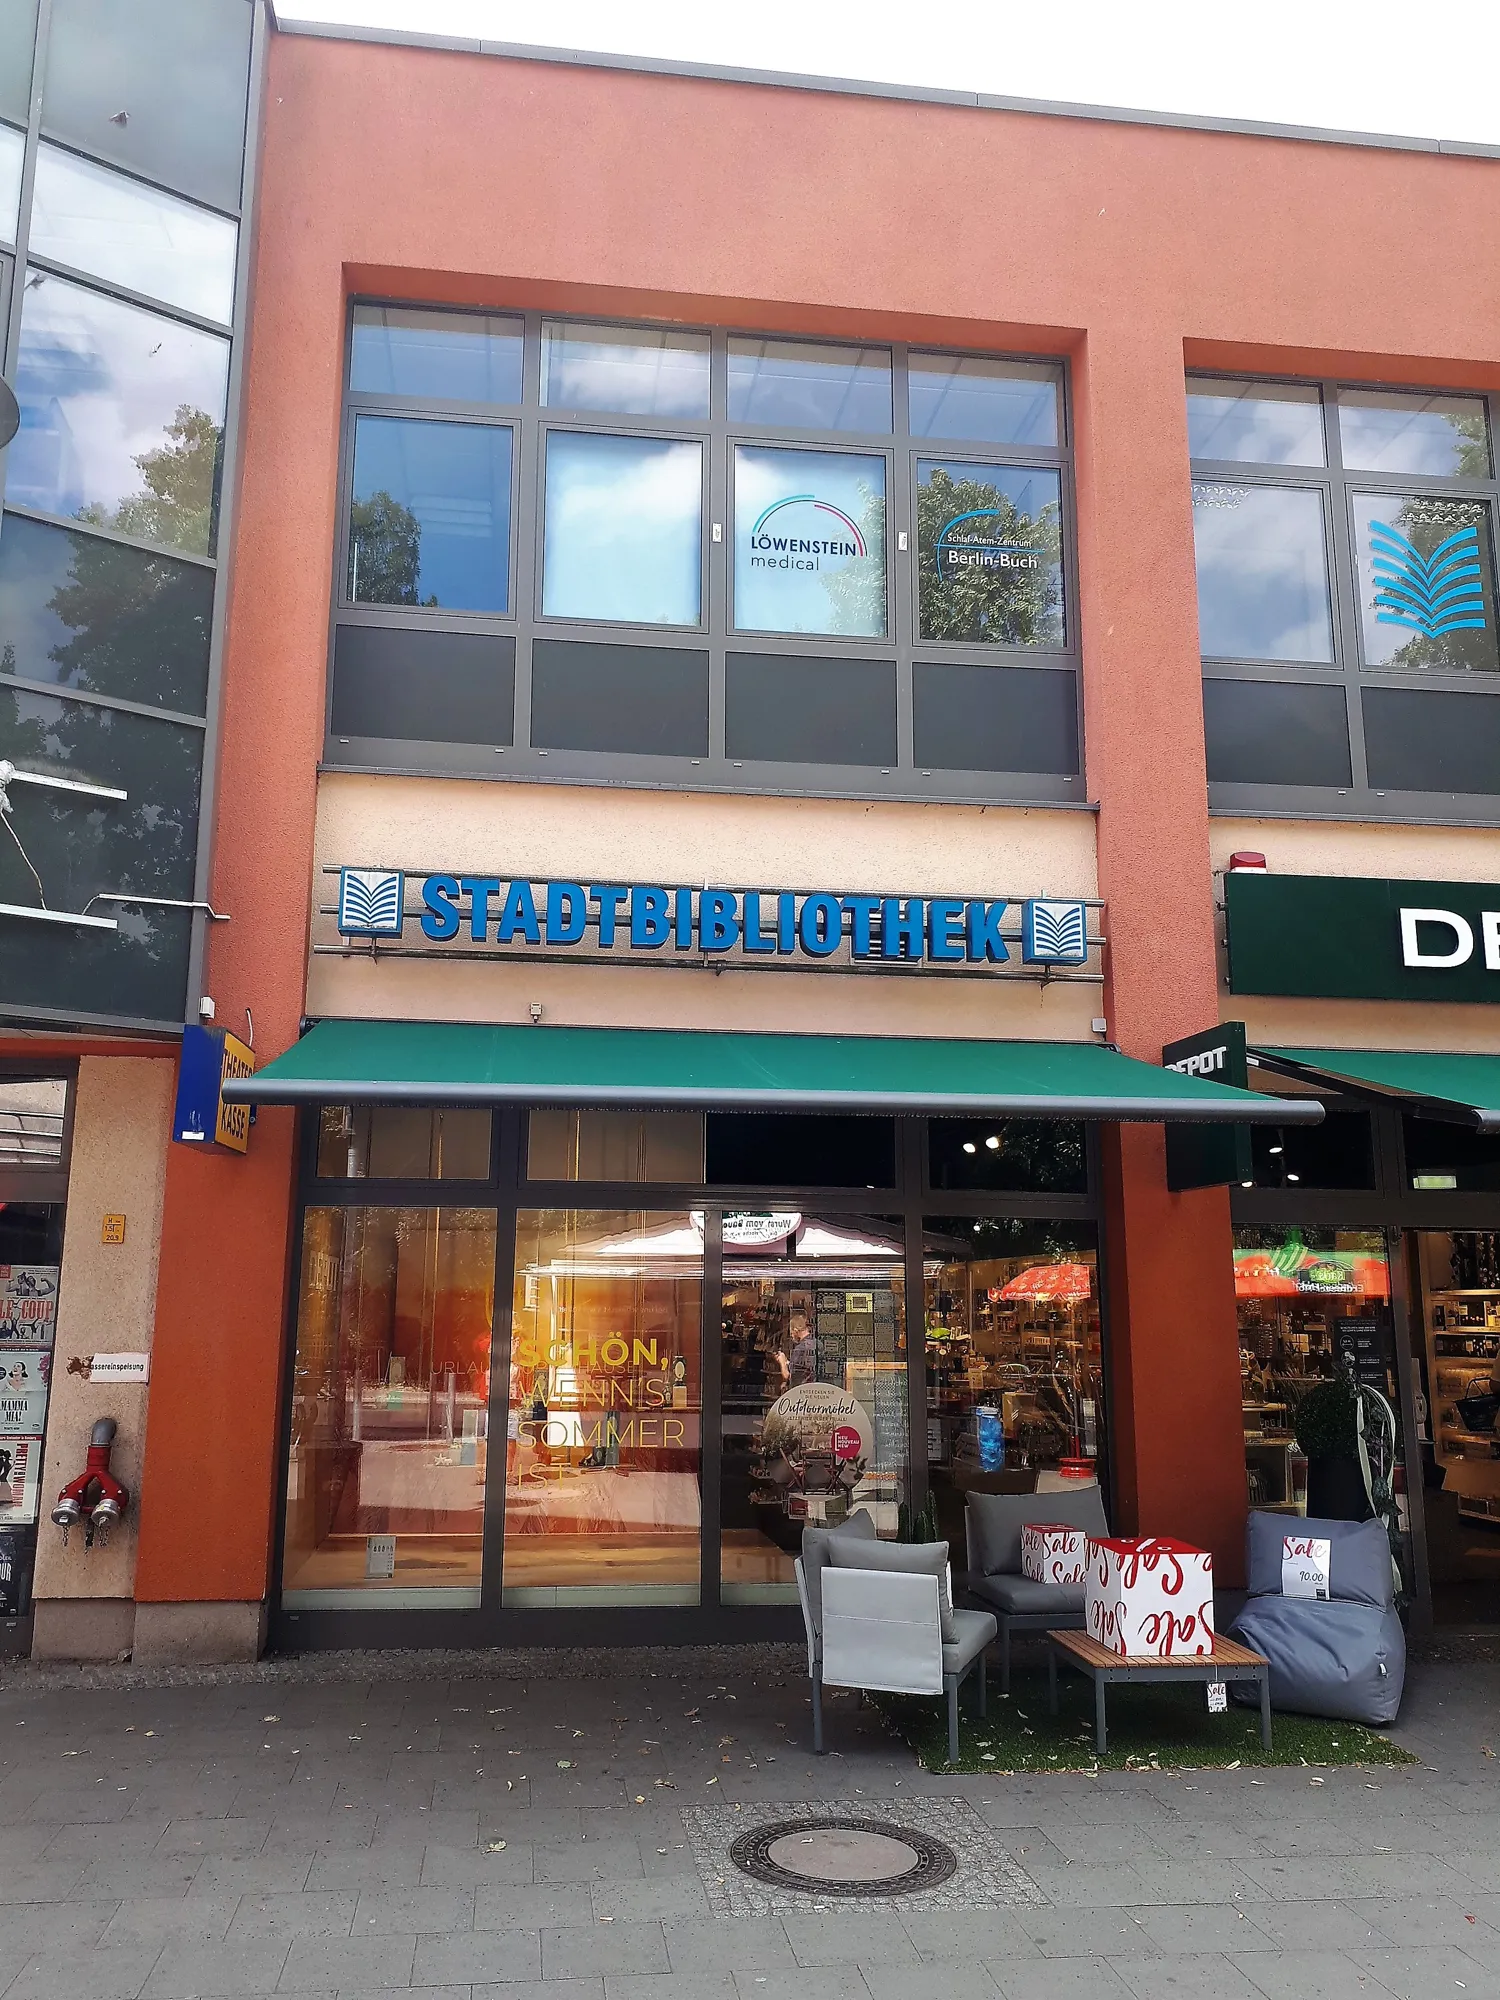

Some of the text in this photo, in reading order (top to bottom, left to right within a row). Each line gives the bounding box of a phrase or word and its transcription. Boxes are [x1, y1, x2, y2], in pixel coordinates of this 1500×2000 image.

[751, 533, 857, 556] LÖWENSTEIN
[947, 533, 1032, 548] Schlaf-Atem-Zentrum
[751, 555, 819, 571] medical
[948, 551, 1038, 569] Berlin-Buch
[420, 874, 1010, 963] STADTBIBLIOTHEK
[1164, 1046, 1227, 1076] EPOT
[221, 1104, 246, 1139] KASSE
[22, 1300, 53, 1319] COUP
[520, 1332, 669, 1370] SCHÖN,
[519, 1379, 665, 1407] WENN'S
[778, 1397, 856, 1416] Outdoormöbel
[517, 1420, 685, 1449] SOMMER
[518, 1462, 572, 1491] IST
[1042, 1533, 1080, 1560] Sale
[1283, 1536, 1327, 1561] Sale
